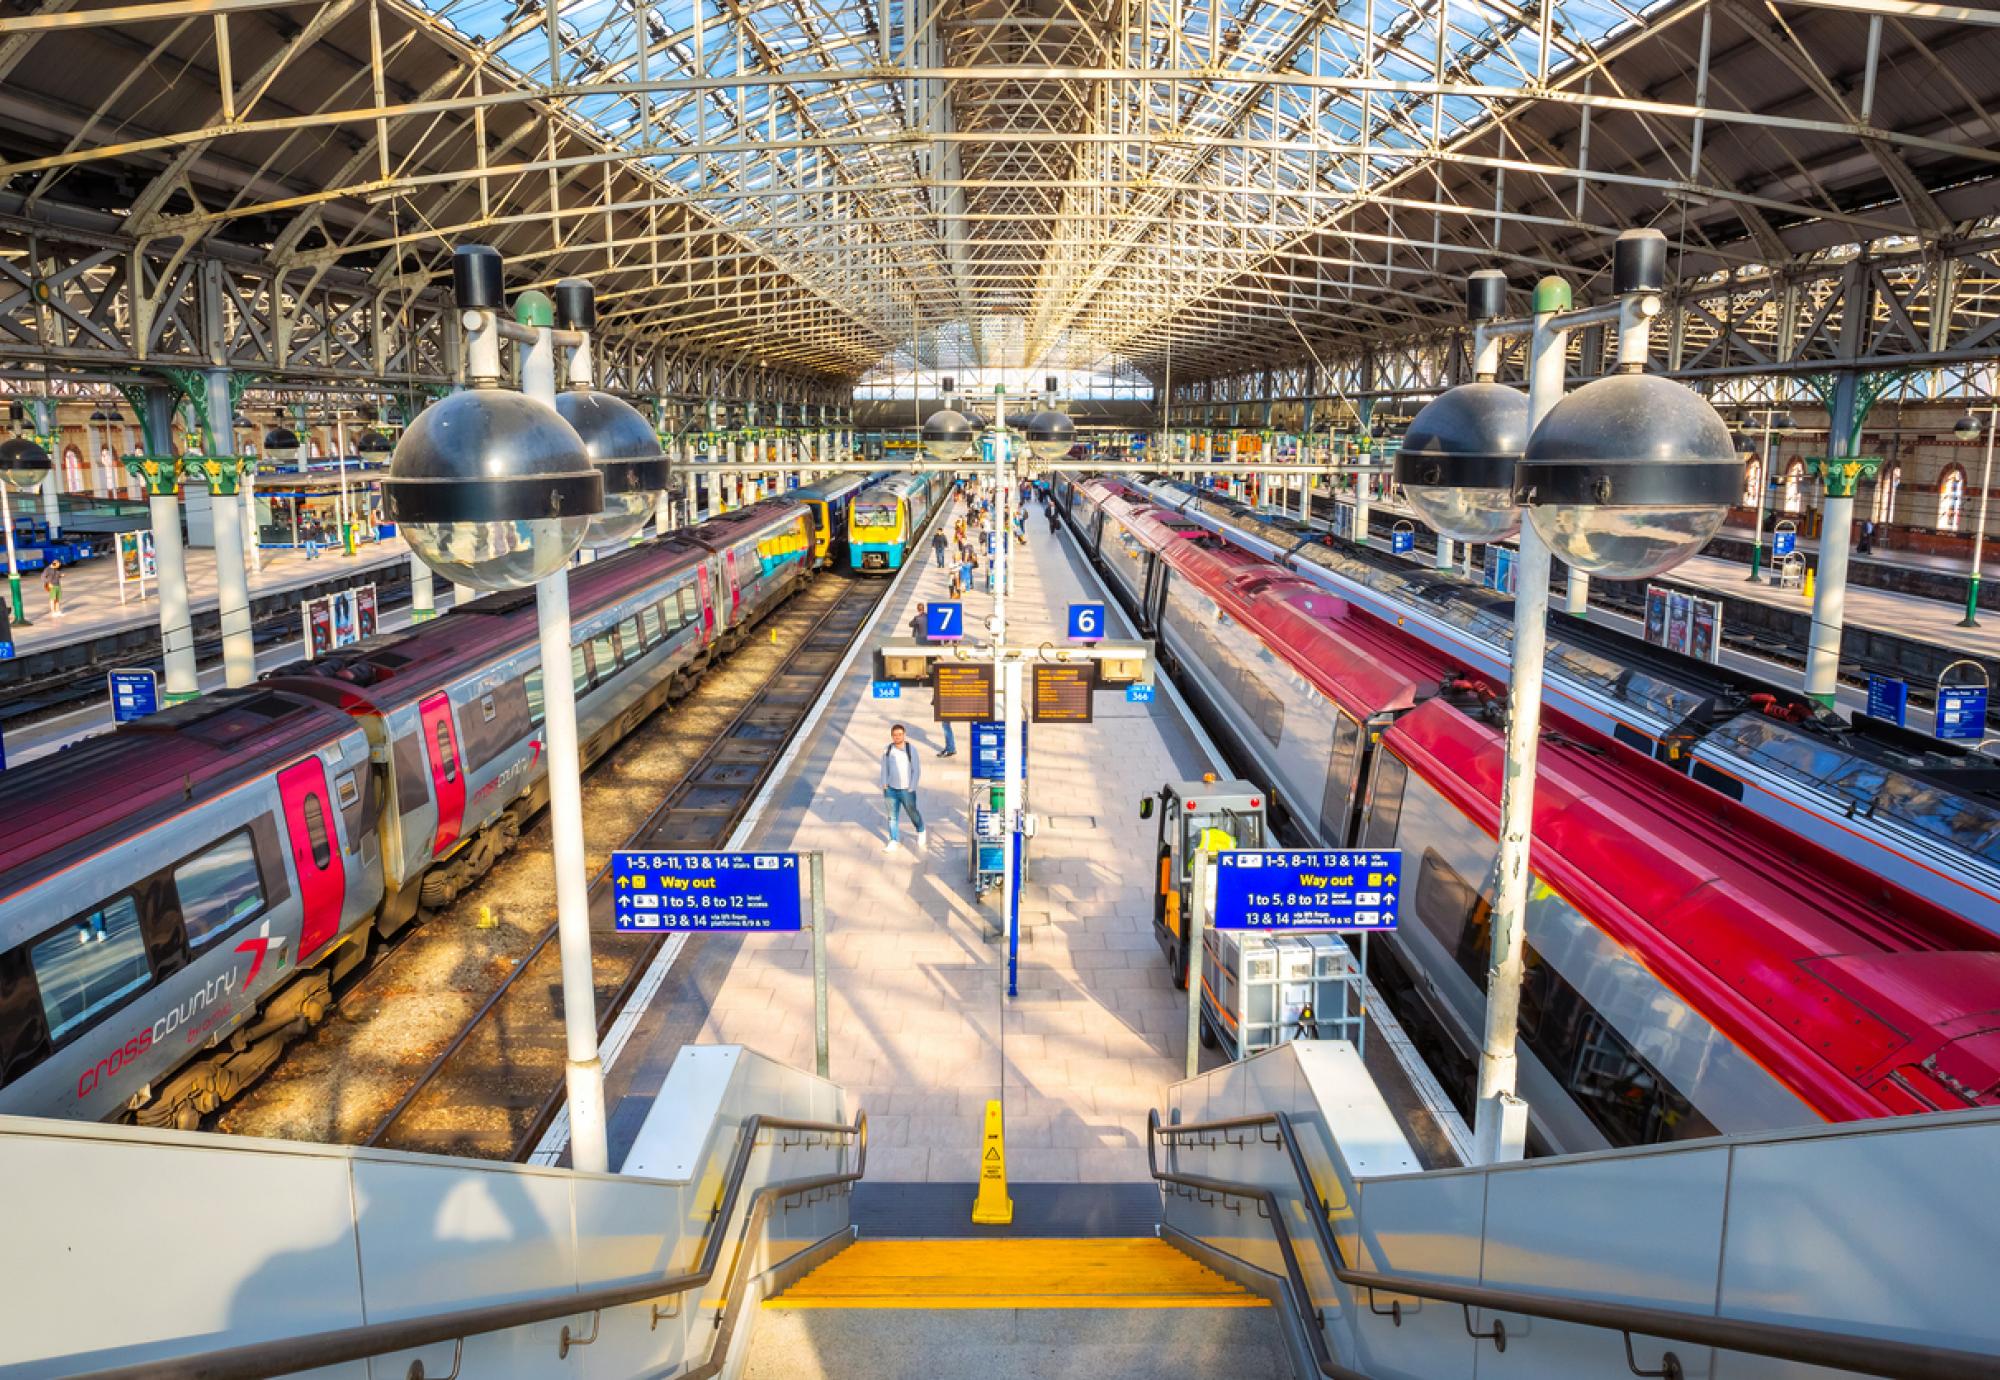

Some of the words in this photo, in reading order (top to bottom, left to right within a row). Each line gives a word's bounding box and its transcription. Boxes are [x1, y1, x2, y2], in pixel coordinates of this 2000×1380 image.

[937, 608, 954, 631] 7
[1078, 609, 1095, 633] 6
[626, 856, 650, 870] 1-5,
[652, 856, 682, 870] 8-11,
[685, 856, 699, 869] 13
[701, 856, 712, 869] &
[715, 857, 729, 869] 14
[1265, 854, 1288, 868] 1-5,
[1291, 854, 1320, 868] 8-11,
[1323, 855, 1337, 866] 13
[1339, 855, 1350, 866] &
[1353, 855, 1367, 866] 14
[660, 875, 689, 891] Way
[692, 876, 716, 889] out
[1299, 874, 1328, 888] Way
[1330, 875, 1354, 887] out
[661, 895, 668, 907] 1
[670, 896, 684, 907] to
[687, 895, 699, 909] 5,
[702, 895, 710, 907] 8
[713, 896, 727, 907] to
[729, 895, 744, 907] 12
[1248, 893, 1254, 905] 1
[1256, 894, 1270, 905] to
[1272, 893, 1284, 907] 5,
[1287, 893, 1296, 905] 8
[1299, 894, 1312, 905] to
[1315, 893, 1328, 905] 12
[663, 914, 676, 927] 13
[679, 914, 690, 927] &
[693, 914, 707, 927] 14
[1246, 913, 1259, 925] 13
[1261, 913, 1273, 925] &
[1275, 913, 1289, 925] 14
[76, 964, 238, 1100] crosscountry
